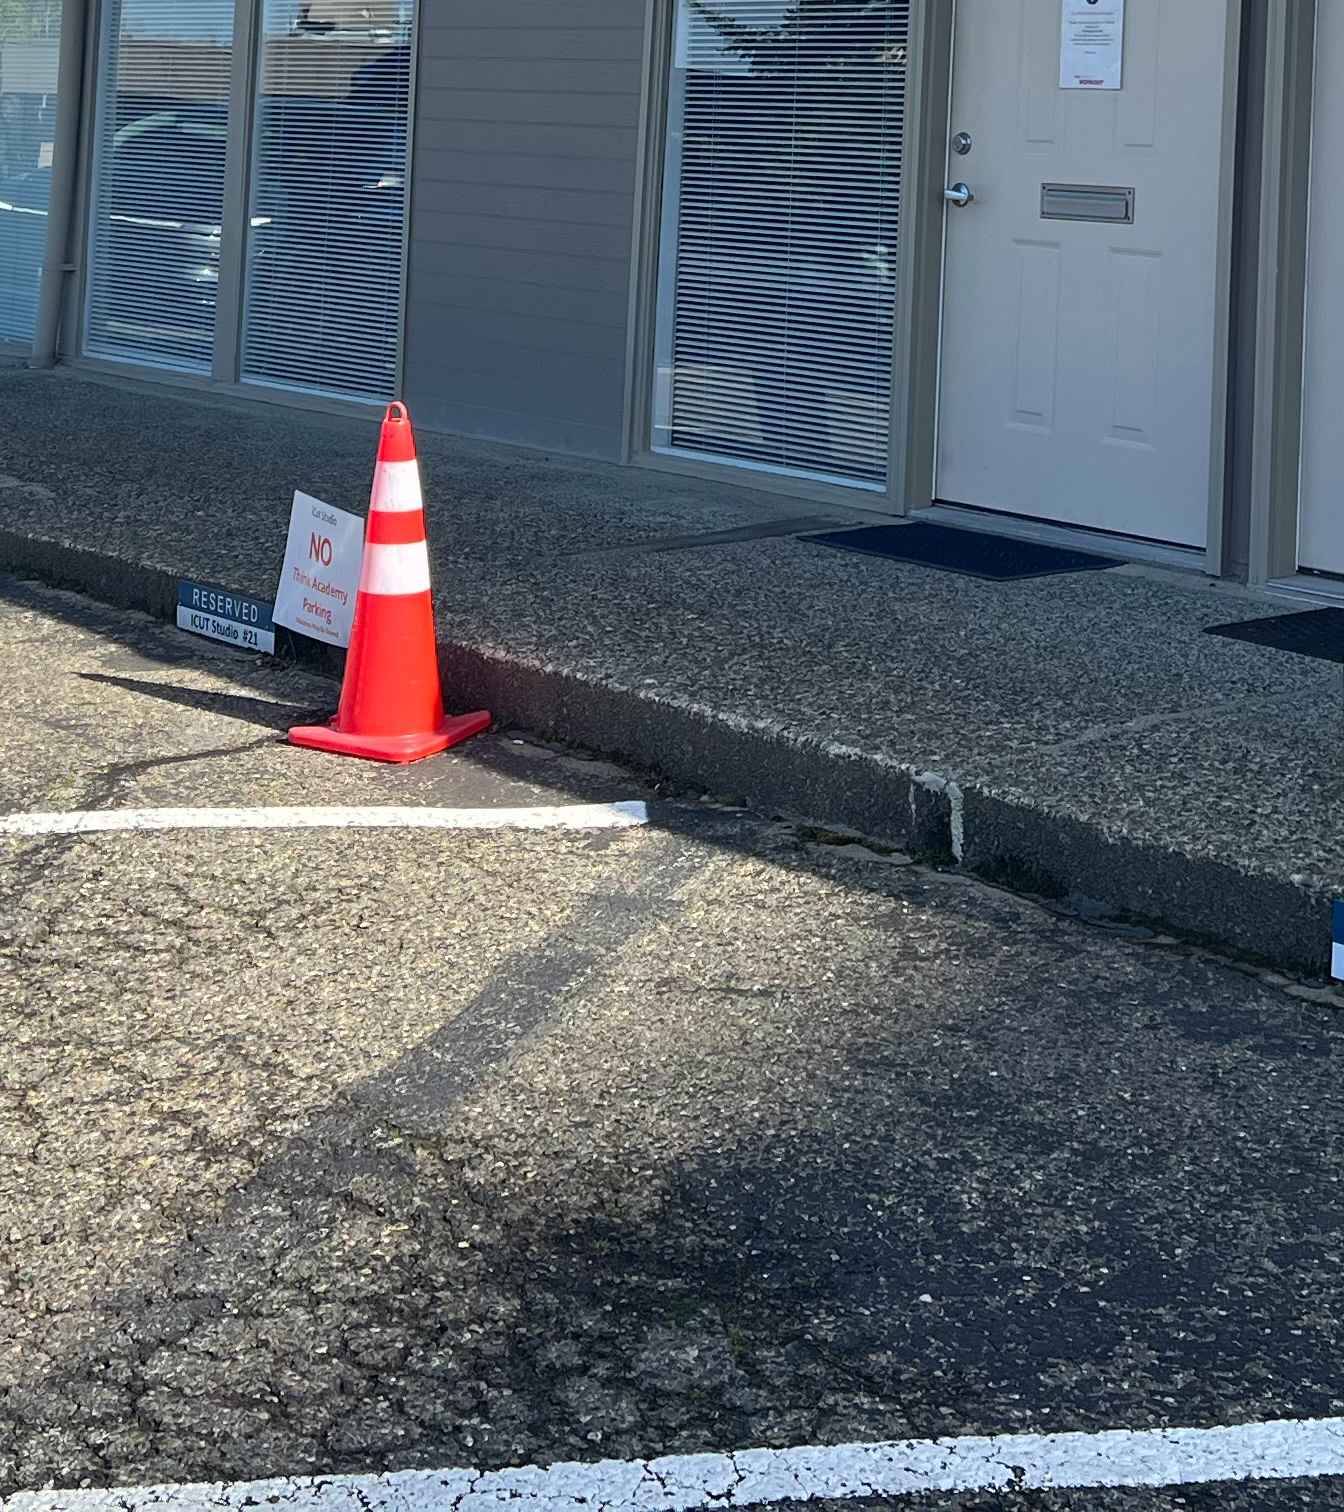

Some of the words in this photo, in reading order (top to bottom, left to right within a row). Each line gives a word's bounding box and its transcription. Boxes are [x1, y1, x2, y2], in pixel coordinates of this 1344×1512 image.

[321, 510, 338, 527] Studio
[309, 531, 333, 567] NO
[292, 566, 311, 587] Think
[311, 576, 348, 606] Academy
[192, 588, 258, 623] RESERVED
[302, 597, 333, 626] Parking
[190, 613, 211, 631] ICUT
[211, 619, 239, 640] Studio
[242, 628, 259, 646] #21
